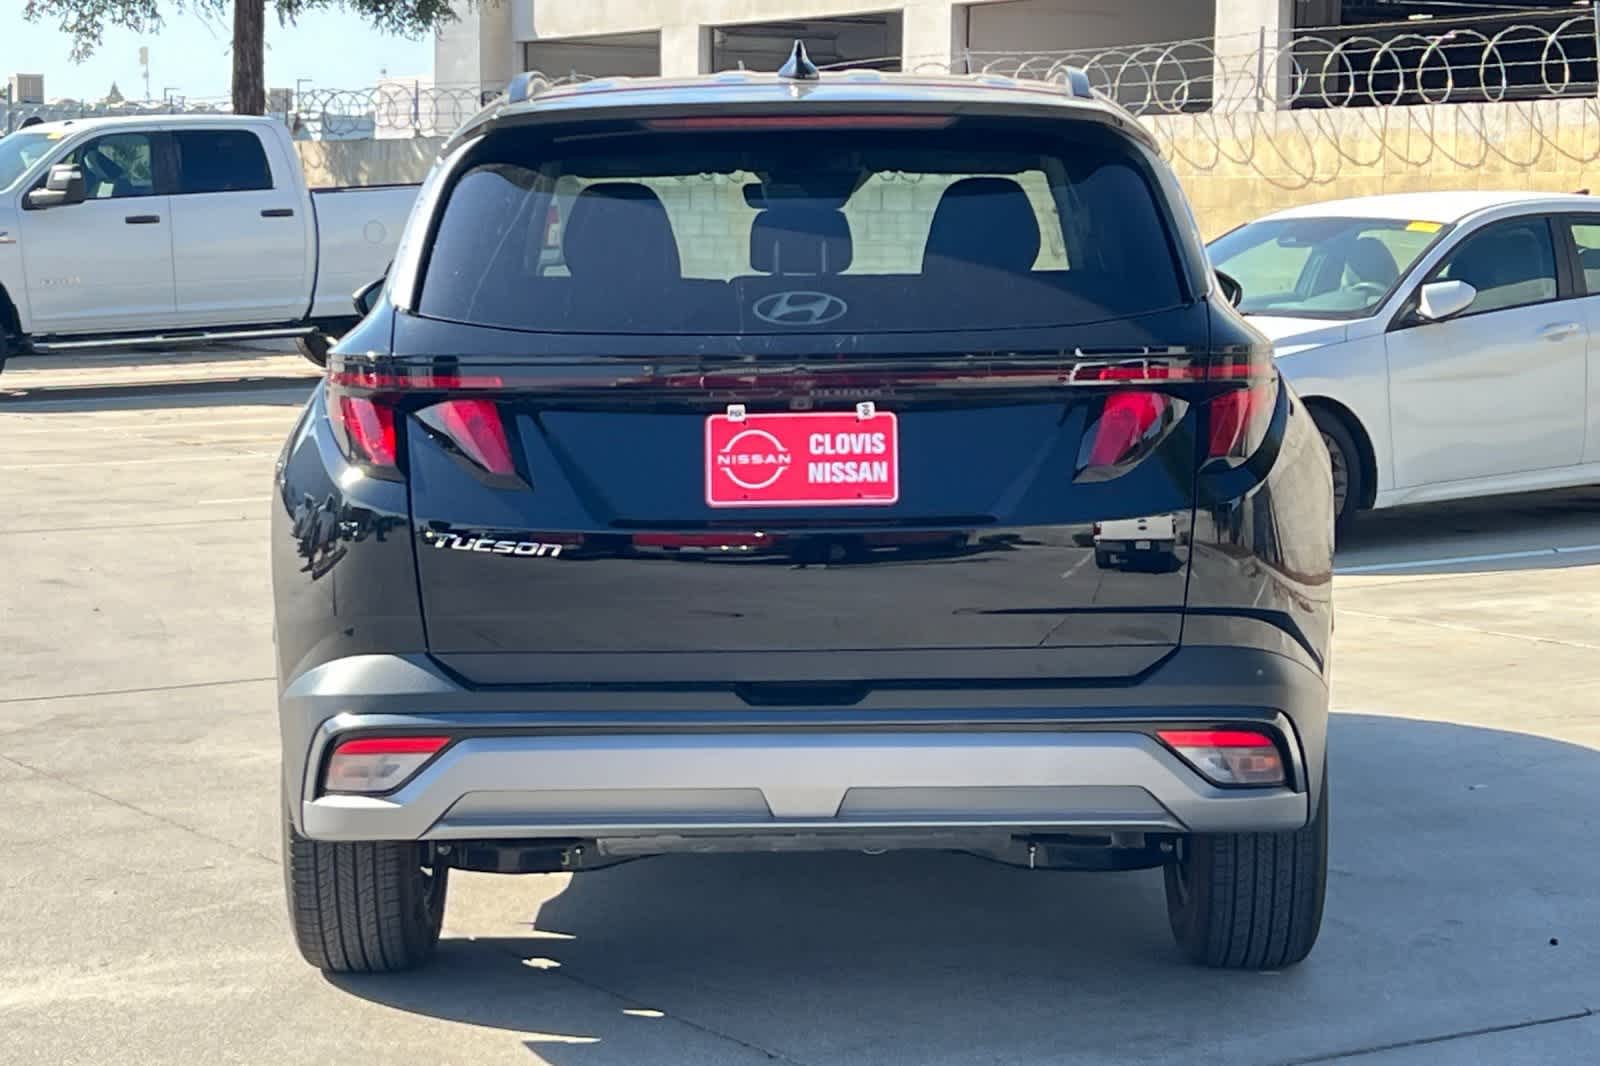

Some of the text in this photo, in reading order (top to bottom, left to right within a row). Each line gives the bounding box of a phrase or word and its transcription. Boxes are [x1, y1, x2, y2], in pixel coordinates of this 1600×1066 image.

[809, 432, 886, 455] CLOVIS
[717, 454, 791, 465] NISSAN
[808, 461, 888, 484] NISSAN
